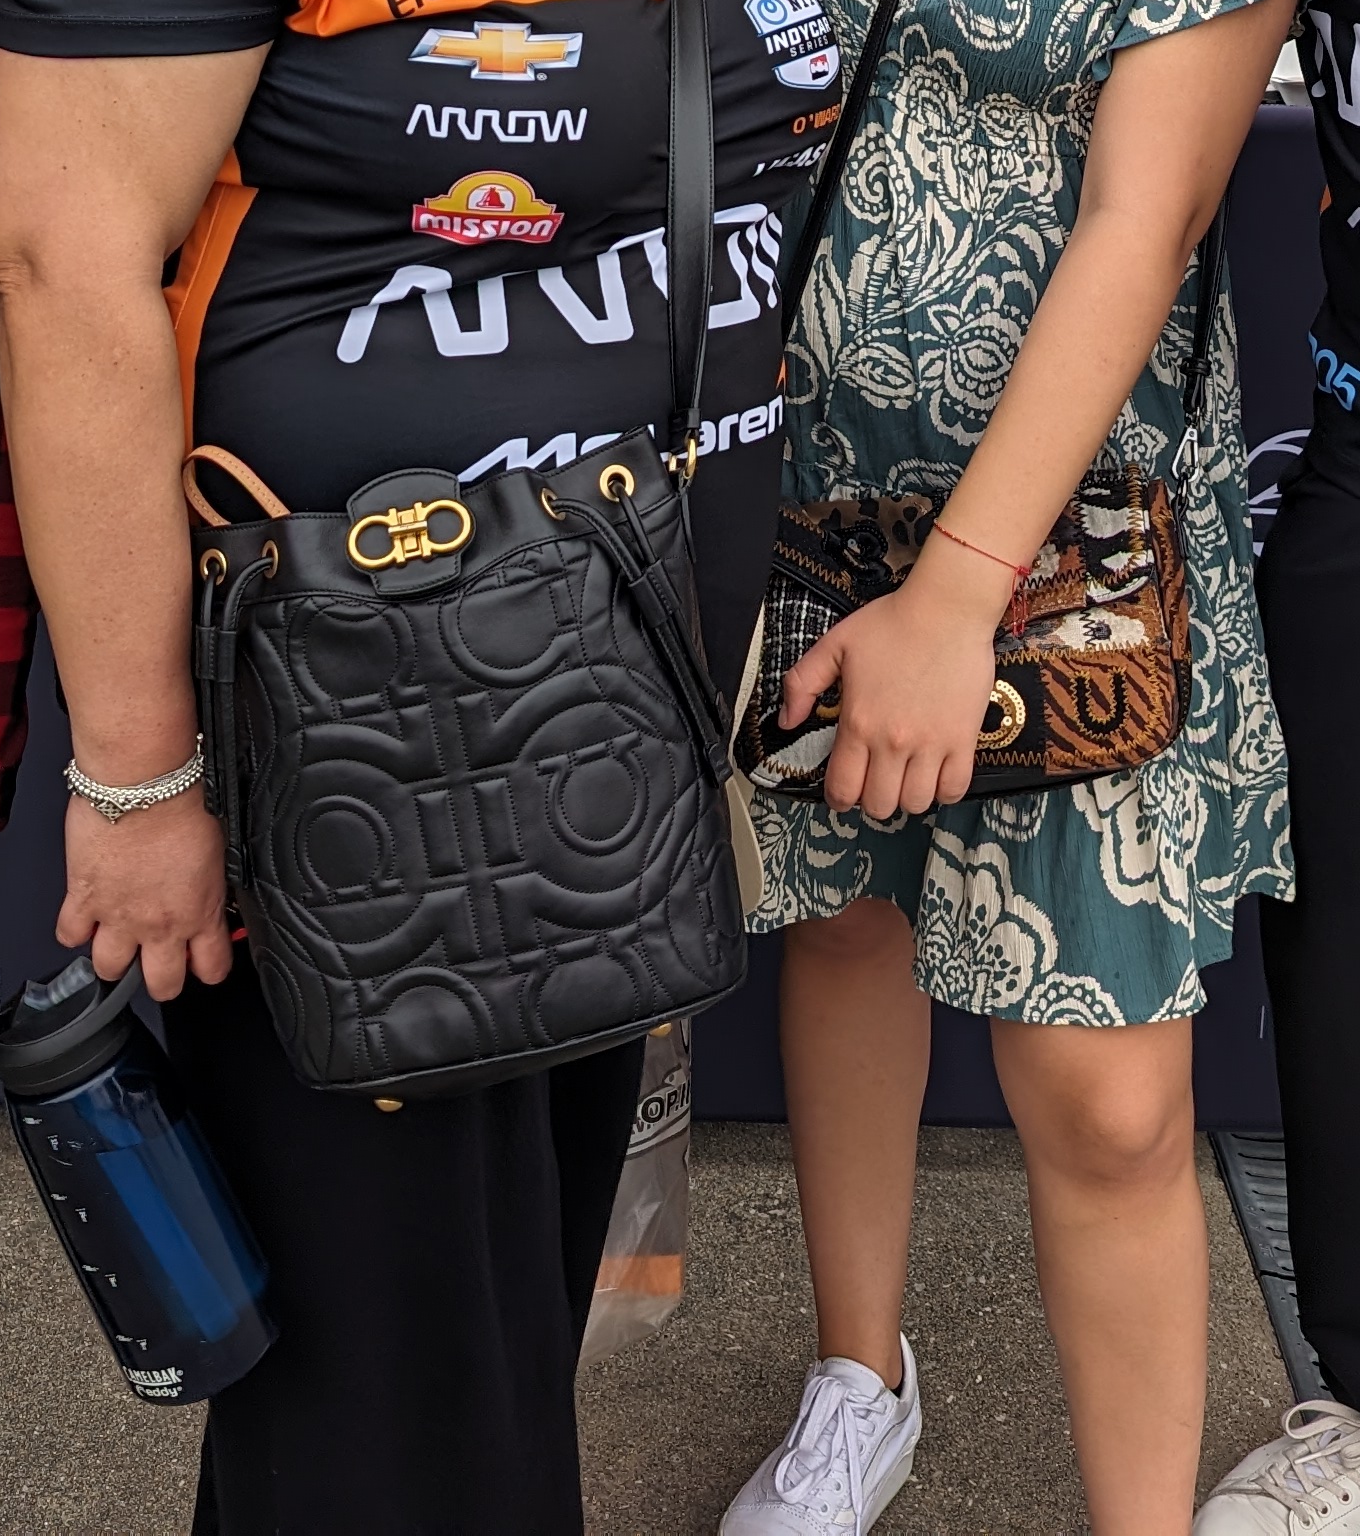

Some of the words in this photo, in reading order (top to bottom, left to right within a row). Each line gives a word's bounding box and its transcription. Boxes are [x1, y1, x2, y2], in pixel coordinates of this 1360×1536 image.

[764, 15, 832, 55] INDYCAR
[789, 34, 830, 58] SERIES
[406, 103, 588, 143] ARROW
[122, 1365, 183, 1386] CAMELBAK
